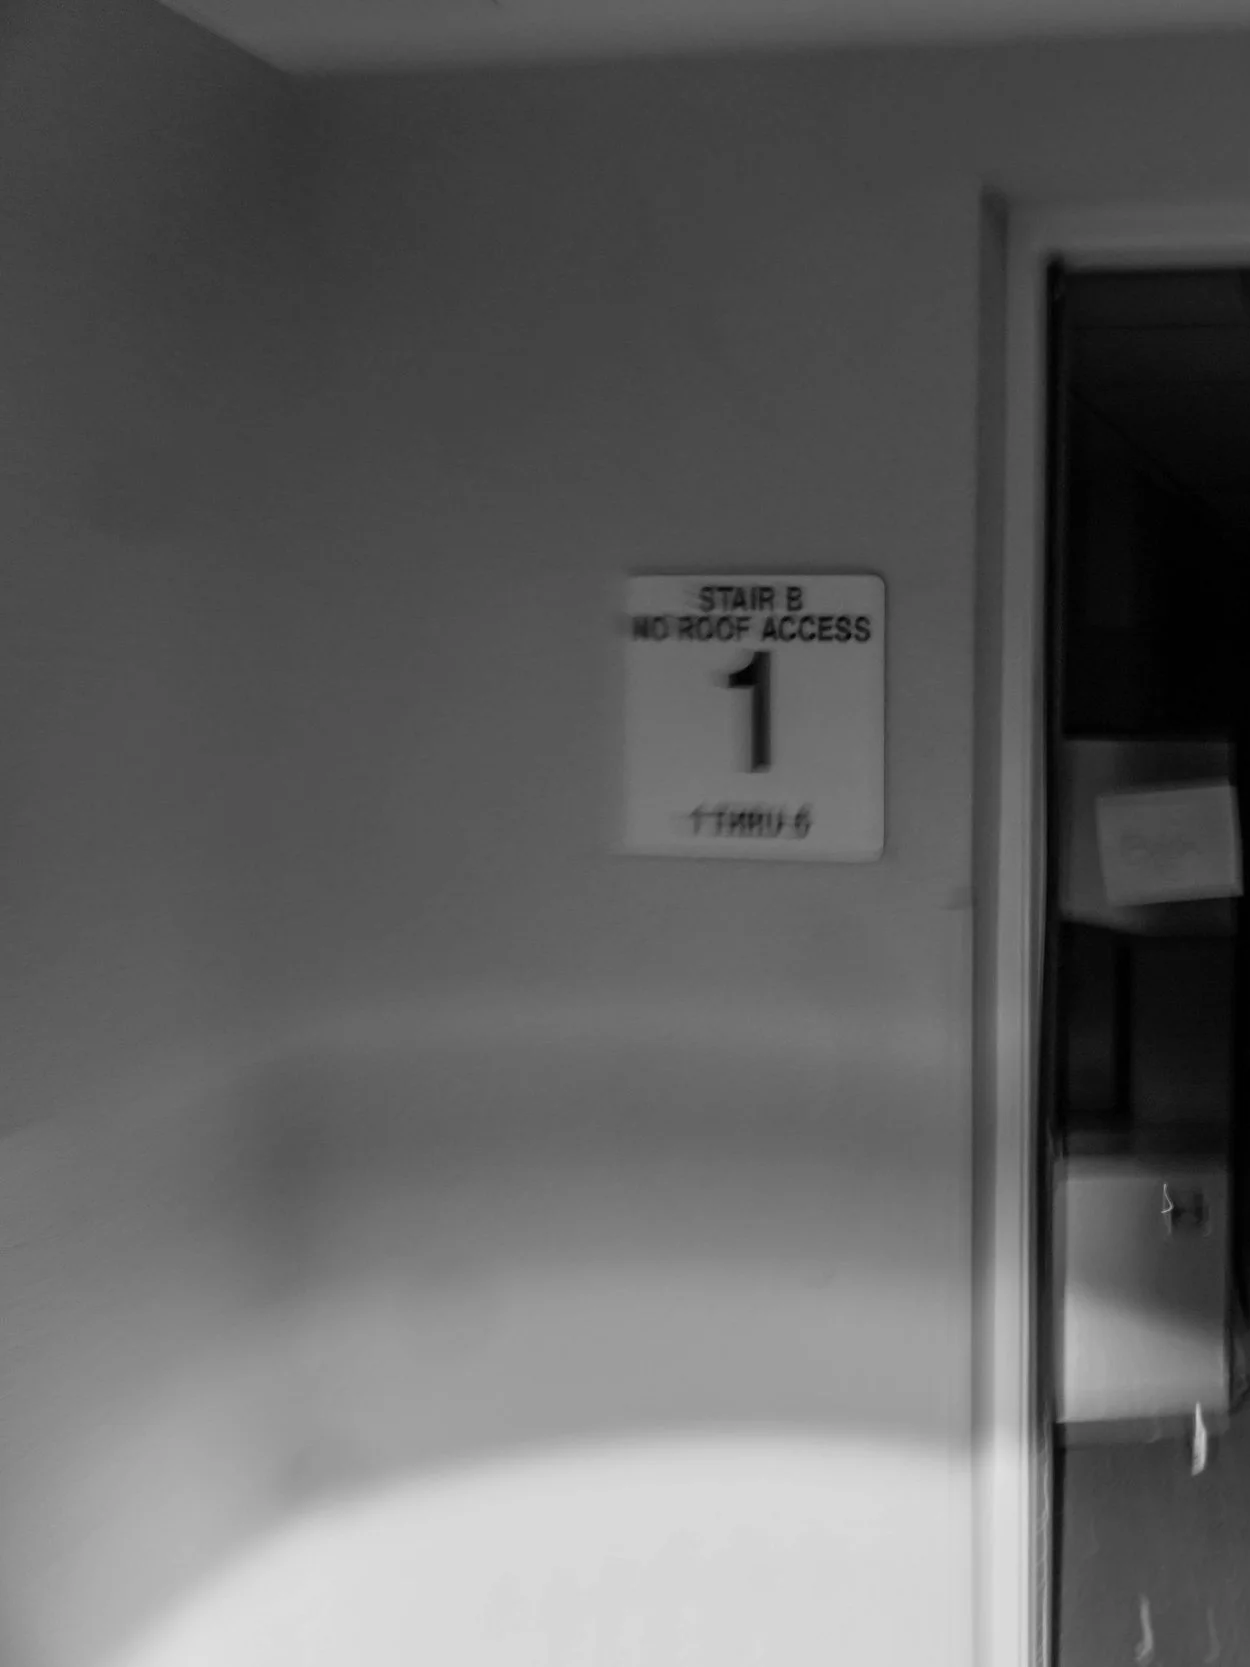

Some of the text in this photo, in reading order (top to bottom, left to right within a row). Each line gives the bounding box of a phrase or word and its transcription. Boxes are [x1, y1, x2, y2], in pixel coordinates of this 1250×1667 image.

[699, 586, 804, 612] STAIR B
[678, 615, 752, 642] ROOF
[760, 615, 872, 642] ACCESS
[727, 650, 771, 773] 1
